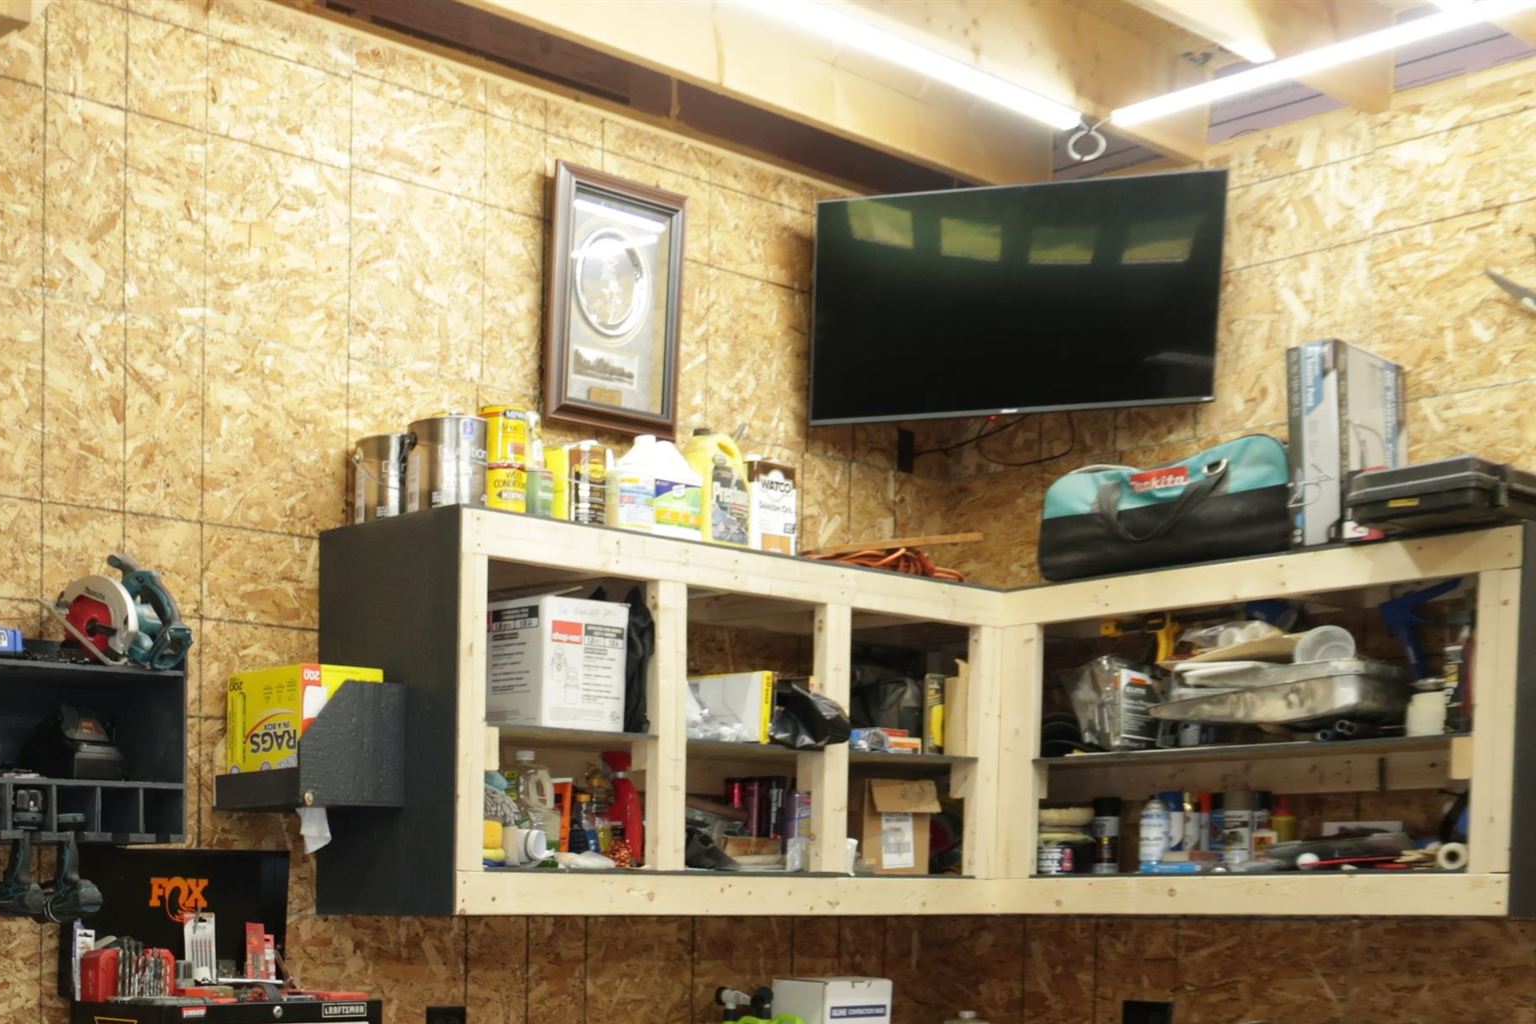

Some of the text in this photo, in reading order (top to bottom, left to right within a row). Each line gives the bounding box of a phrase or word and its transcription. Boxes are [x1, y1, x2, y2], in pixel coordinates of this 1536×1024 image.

[762, 480, 791, 493] WATCO
[303, 669, 320, 681] 200
[250, 729, 297, 754] RAGS
[149, 876, 208, 918] FOX
[325, 1005, 364, 1015] CRAFTSMAN
